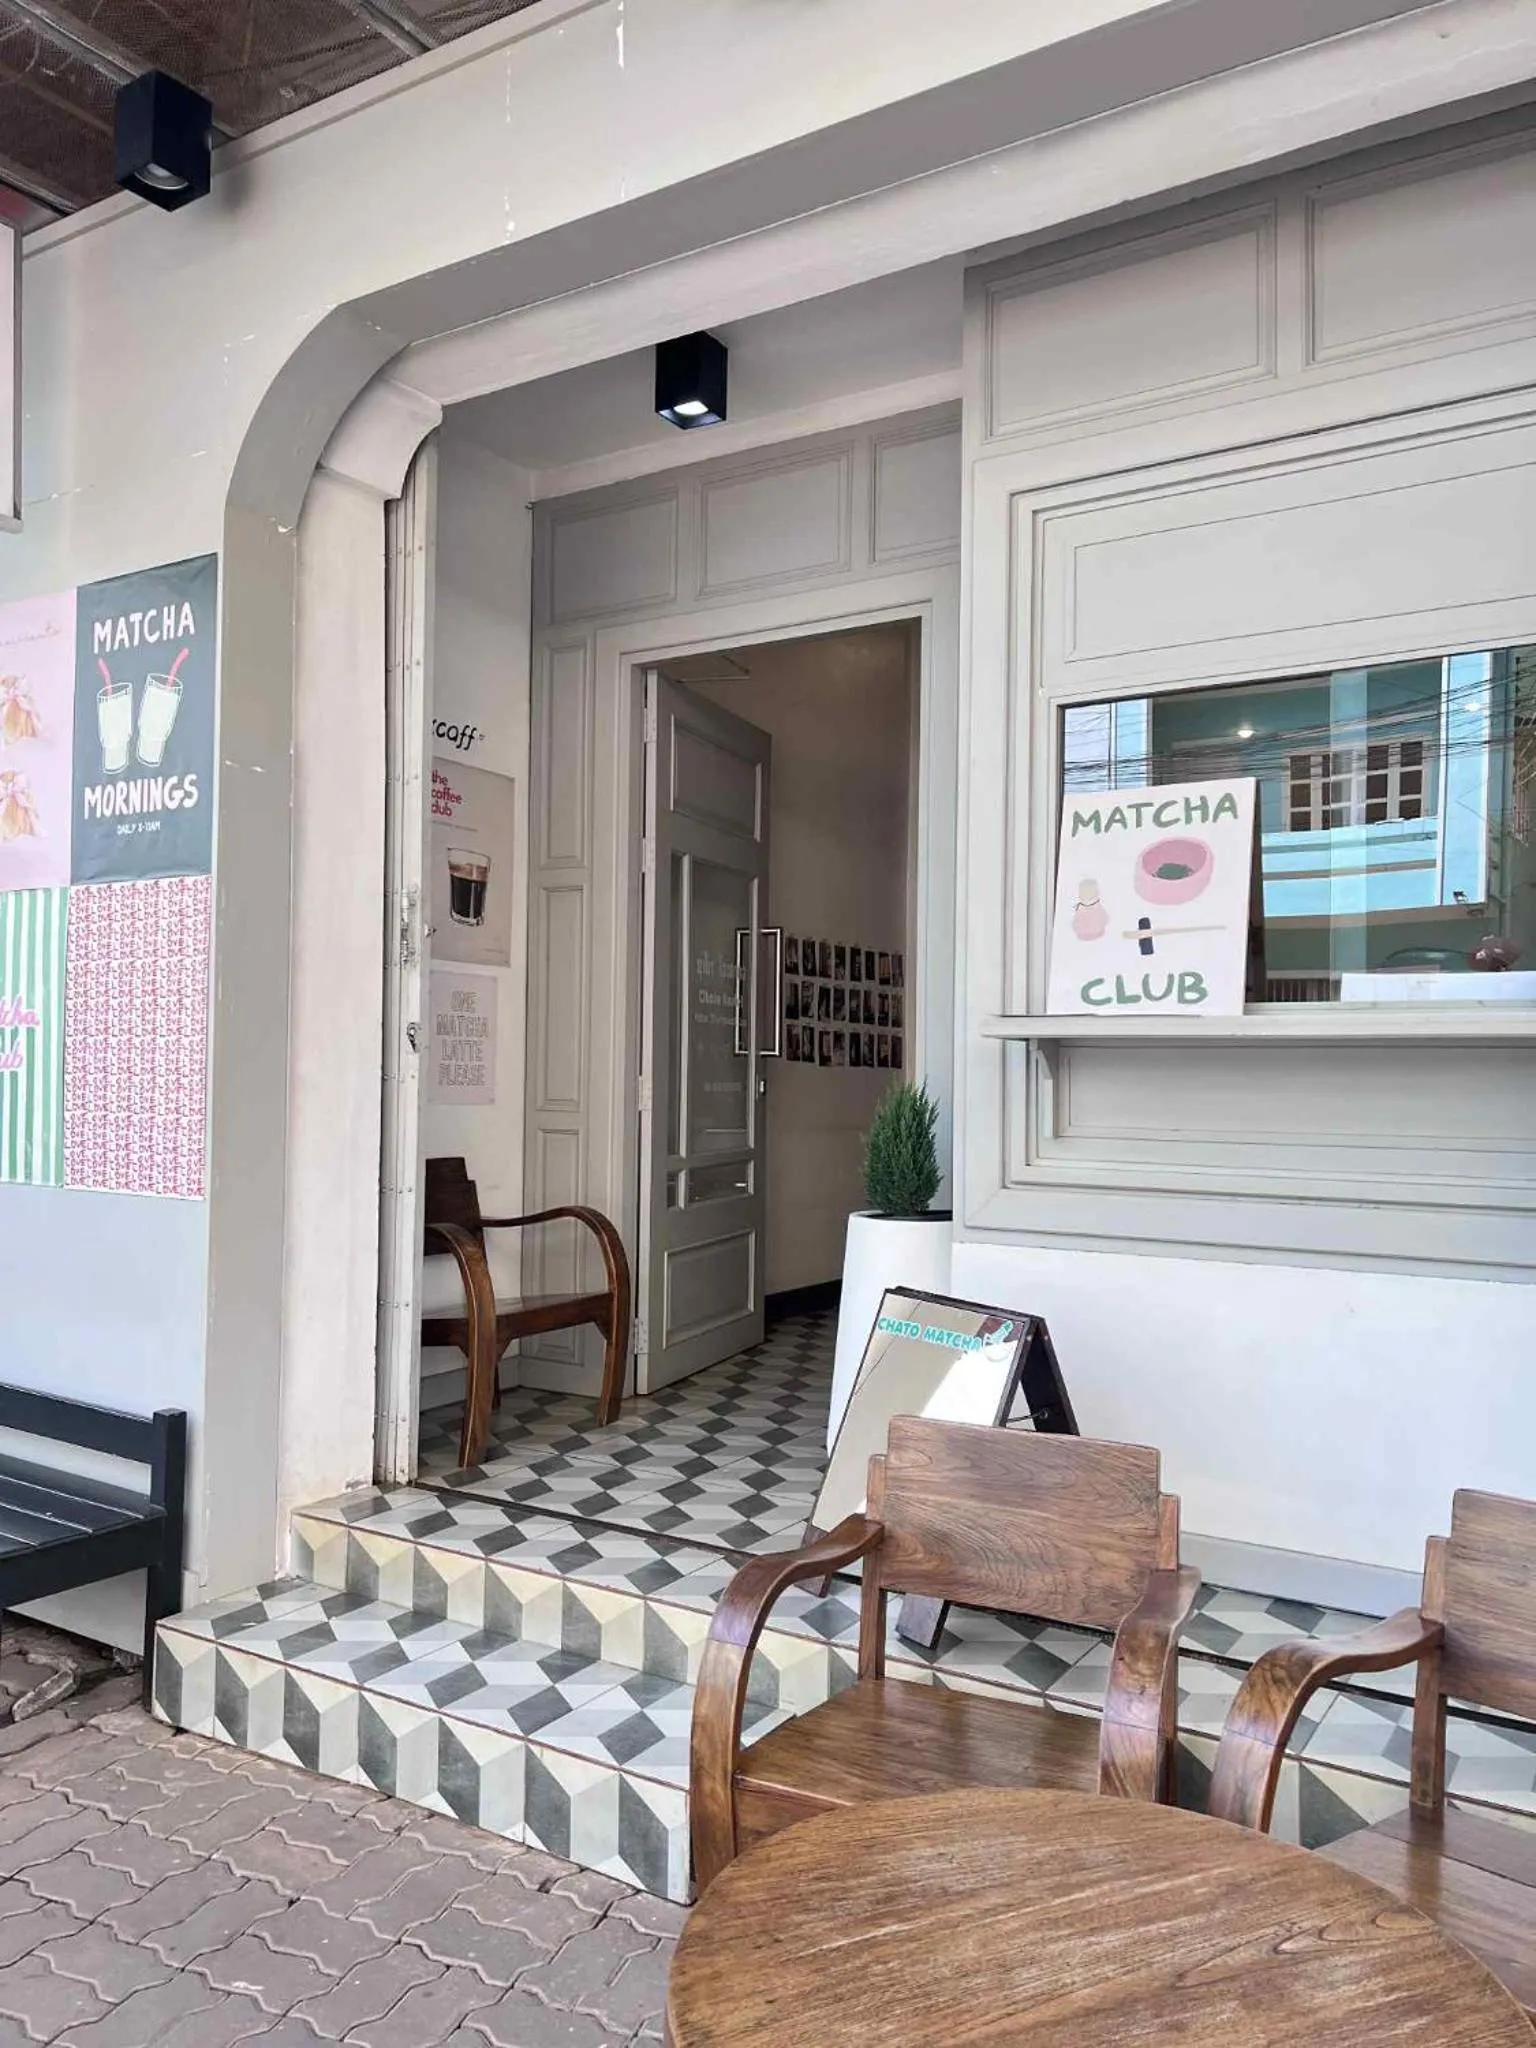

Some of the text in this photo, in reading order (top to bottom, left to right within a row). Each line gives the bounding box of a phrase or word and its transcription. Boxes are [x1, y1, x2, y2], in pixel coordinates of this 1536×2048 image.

[93, 602, 195, 654] MATCHA
[84, 774, 198, 820] MORNINGS
[431, 788, 461, 804] coffee
[1072, 792, 1238, 837] MATCHA
[1080, 971, 1208, 1006] CLUB
[877, 1317, 984, 1353] CHATO MATCHA
